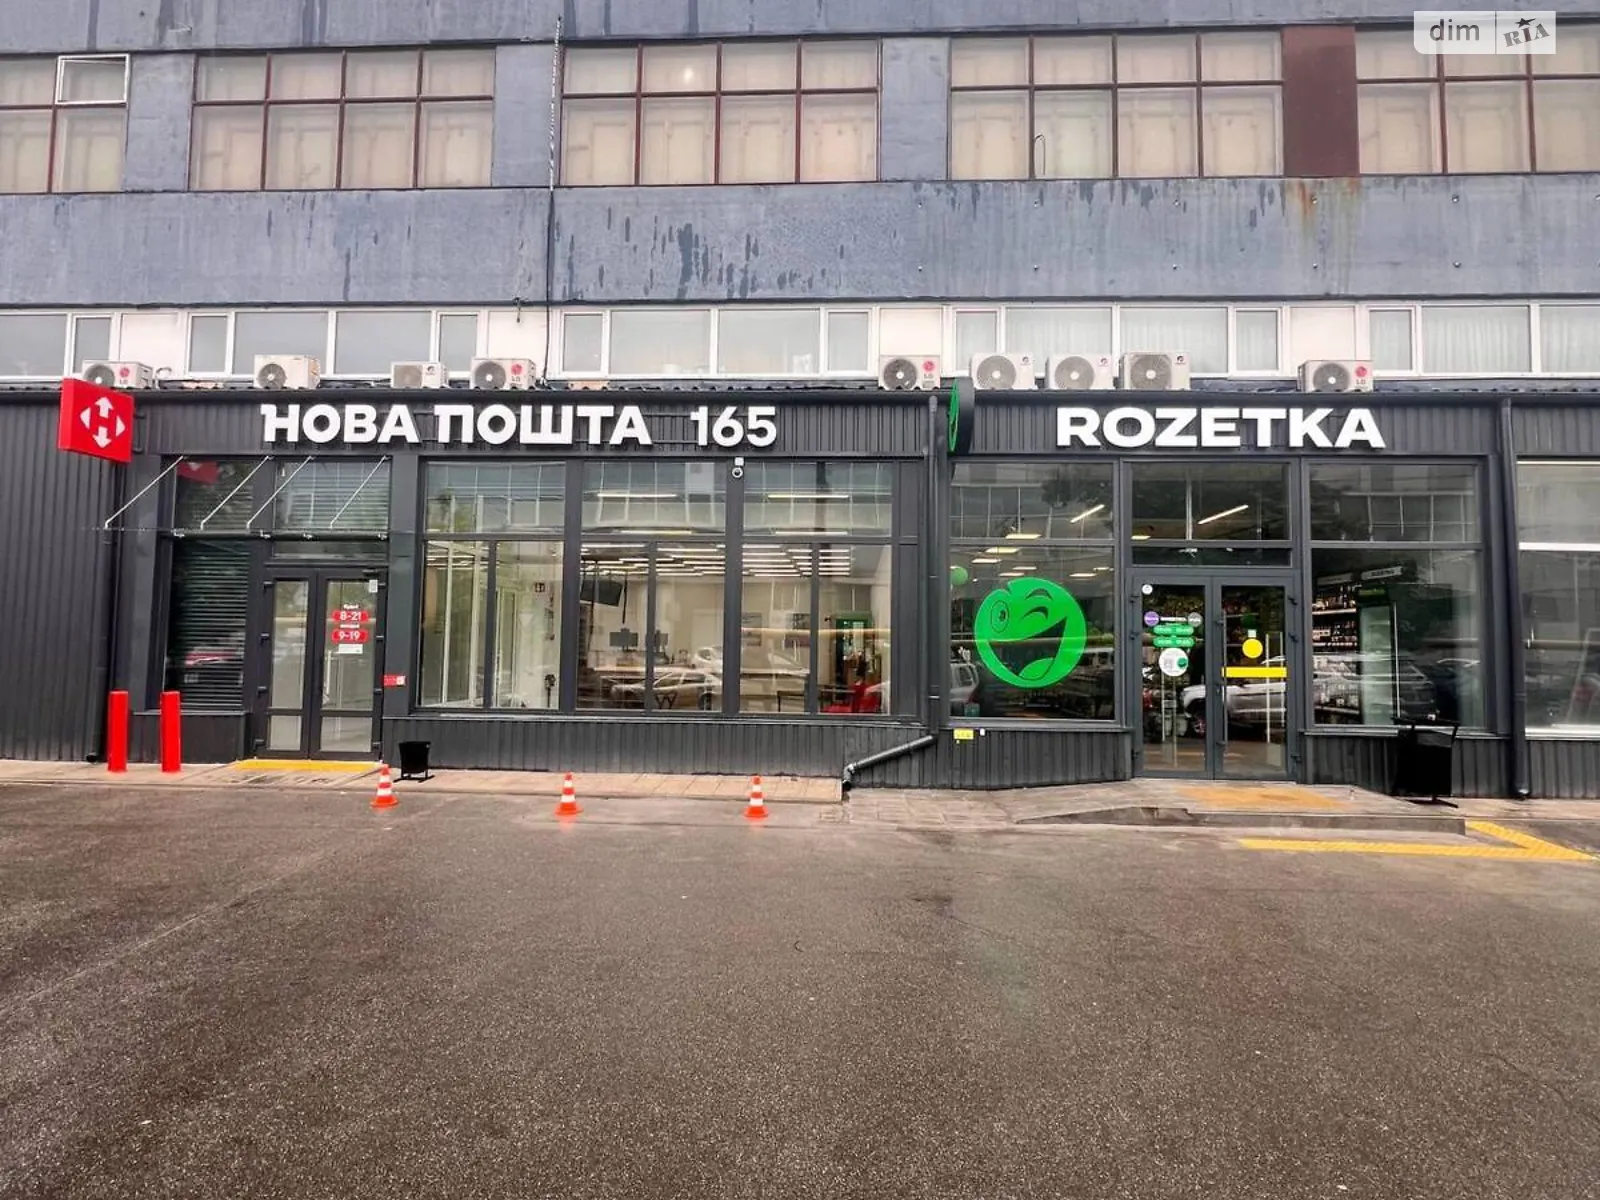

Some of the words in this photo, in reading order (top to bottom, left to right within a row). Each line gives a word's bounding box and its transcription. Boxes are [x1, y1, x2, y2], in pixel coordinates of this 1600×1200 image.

[260, 404, 421, 443] НОВА
[434, 404, 653, 446] ПОШТА
[690, 406, 777, 447] 165
[1056, 407, 1386, 448] ROZETKA
